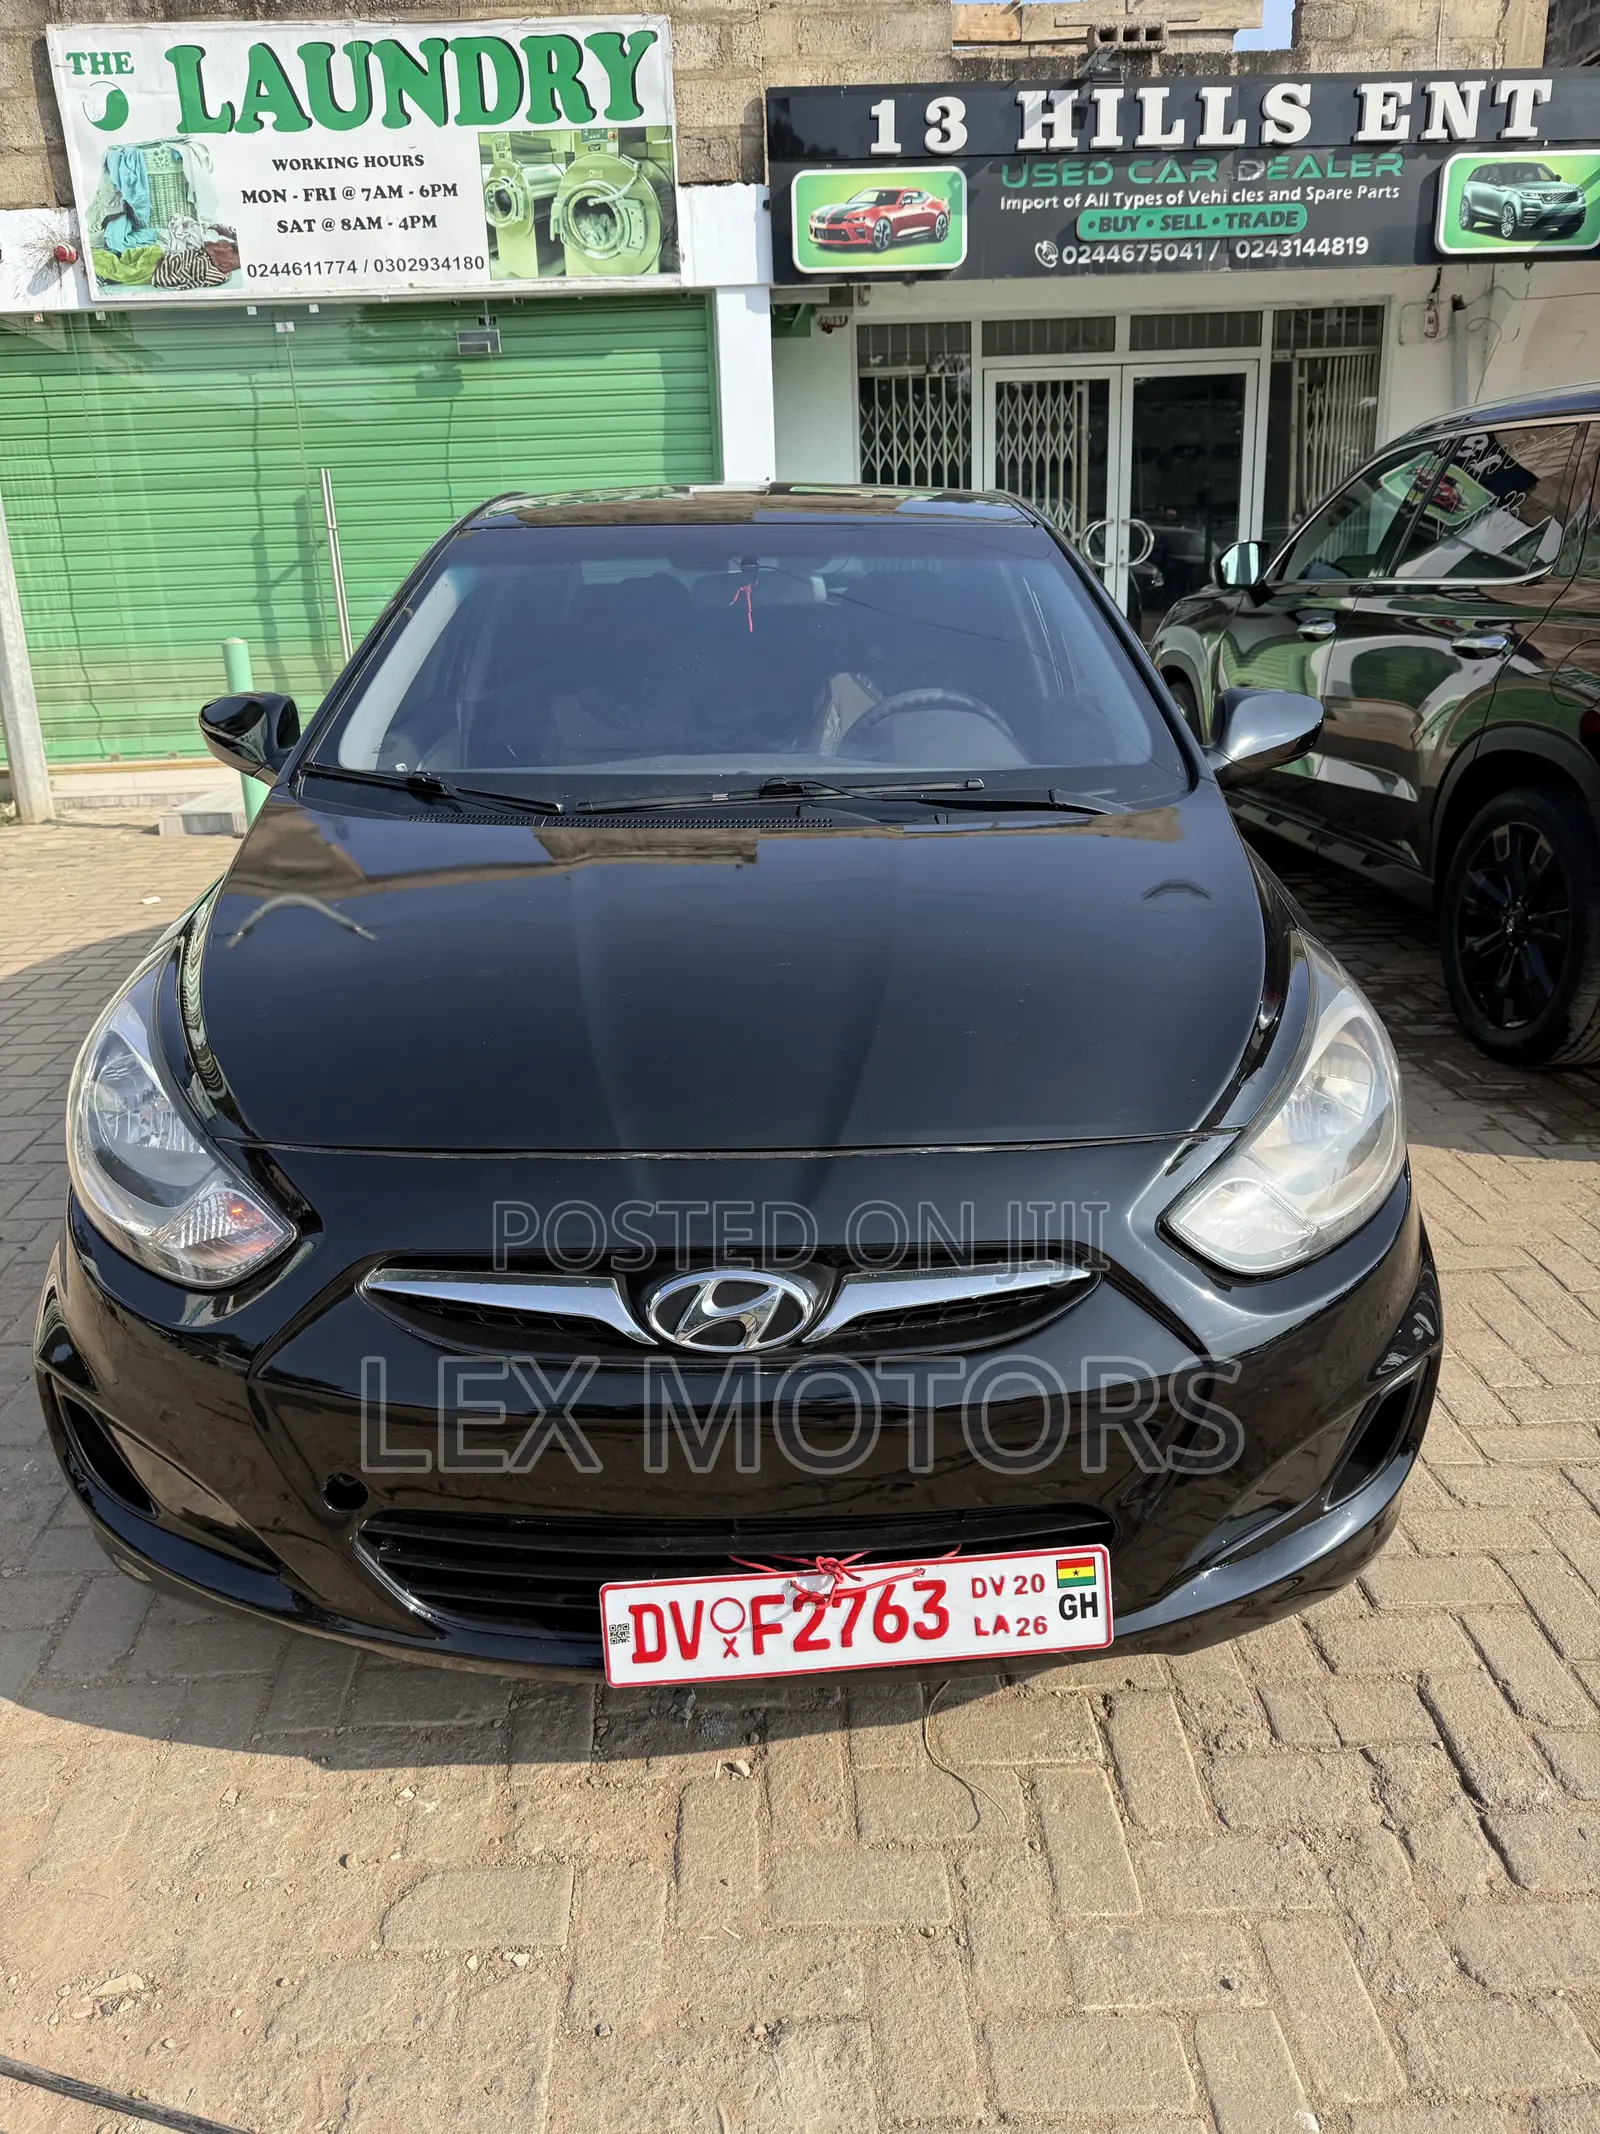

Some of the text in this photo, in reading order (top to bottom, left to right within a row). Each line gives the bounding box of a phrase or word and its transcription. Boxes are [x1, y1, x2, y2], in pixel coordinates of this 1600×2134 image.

[65, 30, 659, 135] THE LAUNDRY
[1016, 81, 1312, 151] HILLS
[1350, 79, 1553, 143] ENT
[271, 154, 425, 171] WORKING HOURS
[1001, 152, 1404, 188] USED CAR DEALER
[240, 188, 287, 204] MON
[303, 187, 337, 202] FRI
[341, 185, 356, 201] @
[361, 185, 404, 201] 7AM
[419, 183, 458, 198] 6PM
[1000, 195, 1059, 214] Import
[1063, 193, 1082, 209] of
[1084, 192, 1109, 208] All
[1112, 191, 1162, 210] Types
[1166, 189, 1186, 205] of
[1268, 186, 1301, 201] and
[1305, 185, 1353, 204] Spare
[1357, 184, 1400, 200] Parts
[276, 219, 316, 234] SAT
[321, 217, 336, 232] @
[340, 216, 383, 231] 8AM
[398, 214, 438, 231] 4PM
[1098, 209, 1299, 233] BUY SELL TRADE
[1235, 236, 1369, 259] 0243144819
[246, 260, 358, 278] 0244611774
[373, 256, 485, 273] 0302934180
[971, 1573, 1045, 1599] DV 20
[1058, 1592, 1099, 1621] GH
[628, 1600, 705, 1664] DV
[751, 1578, 950, 1655] F2763
[974, 1614, 1048, 1637] LA 26
